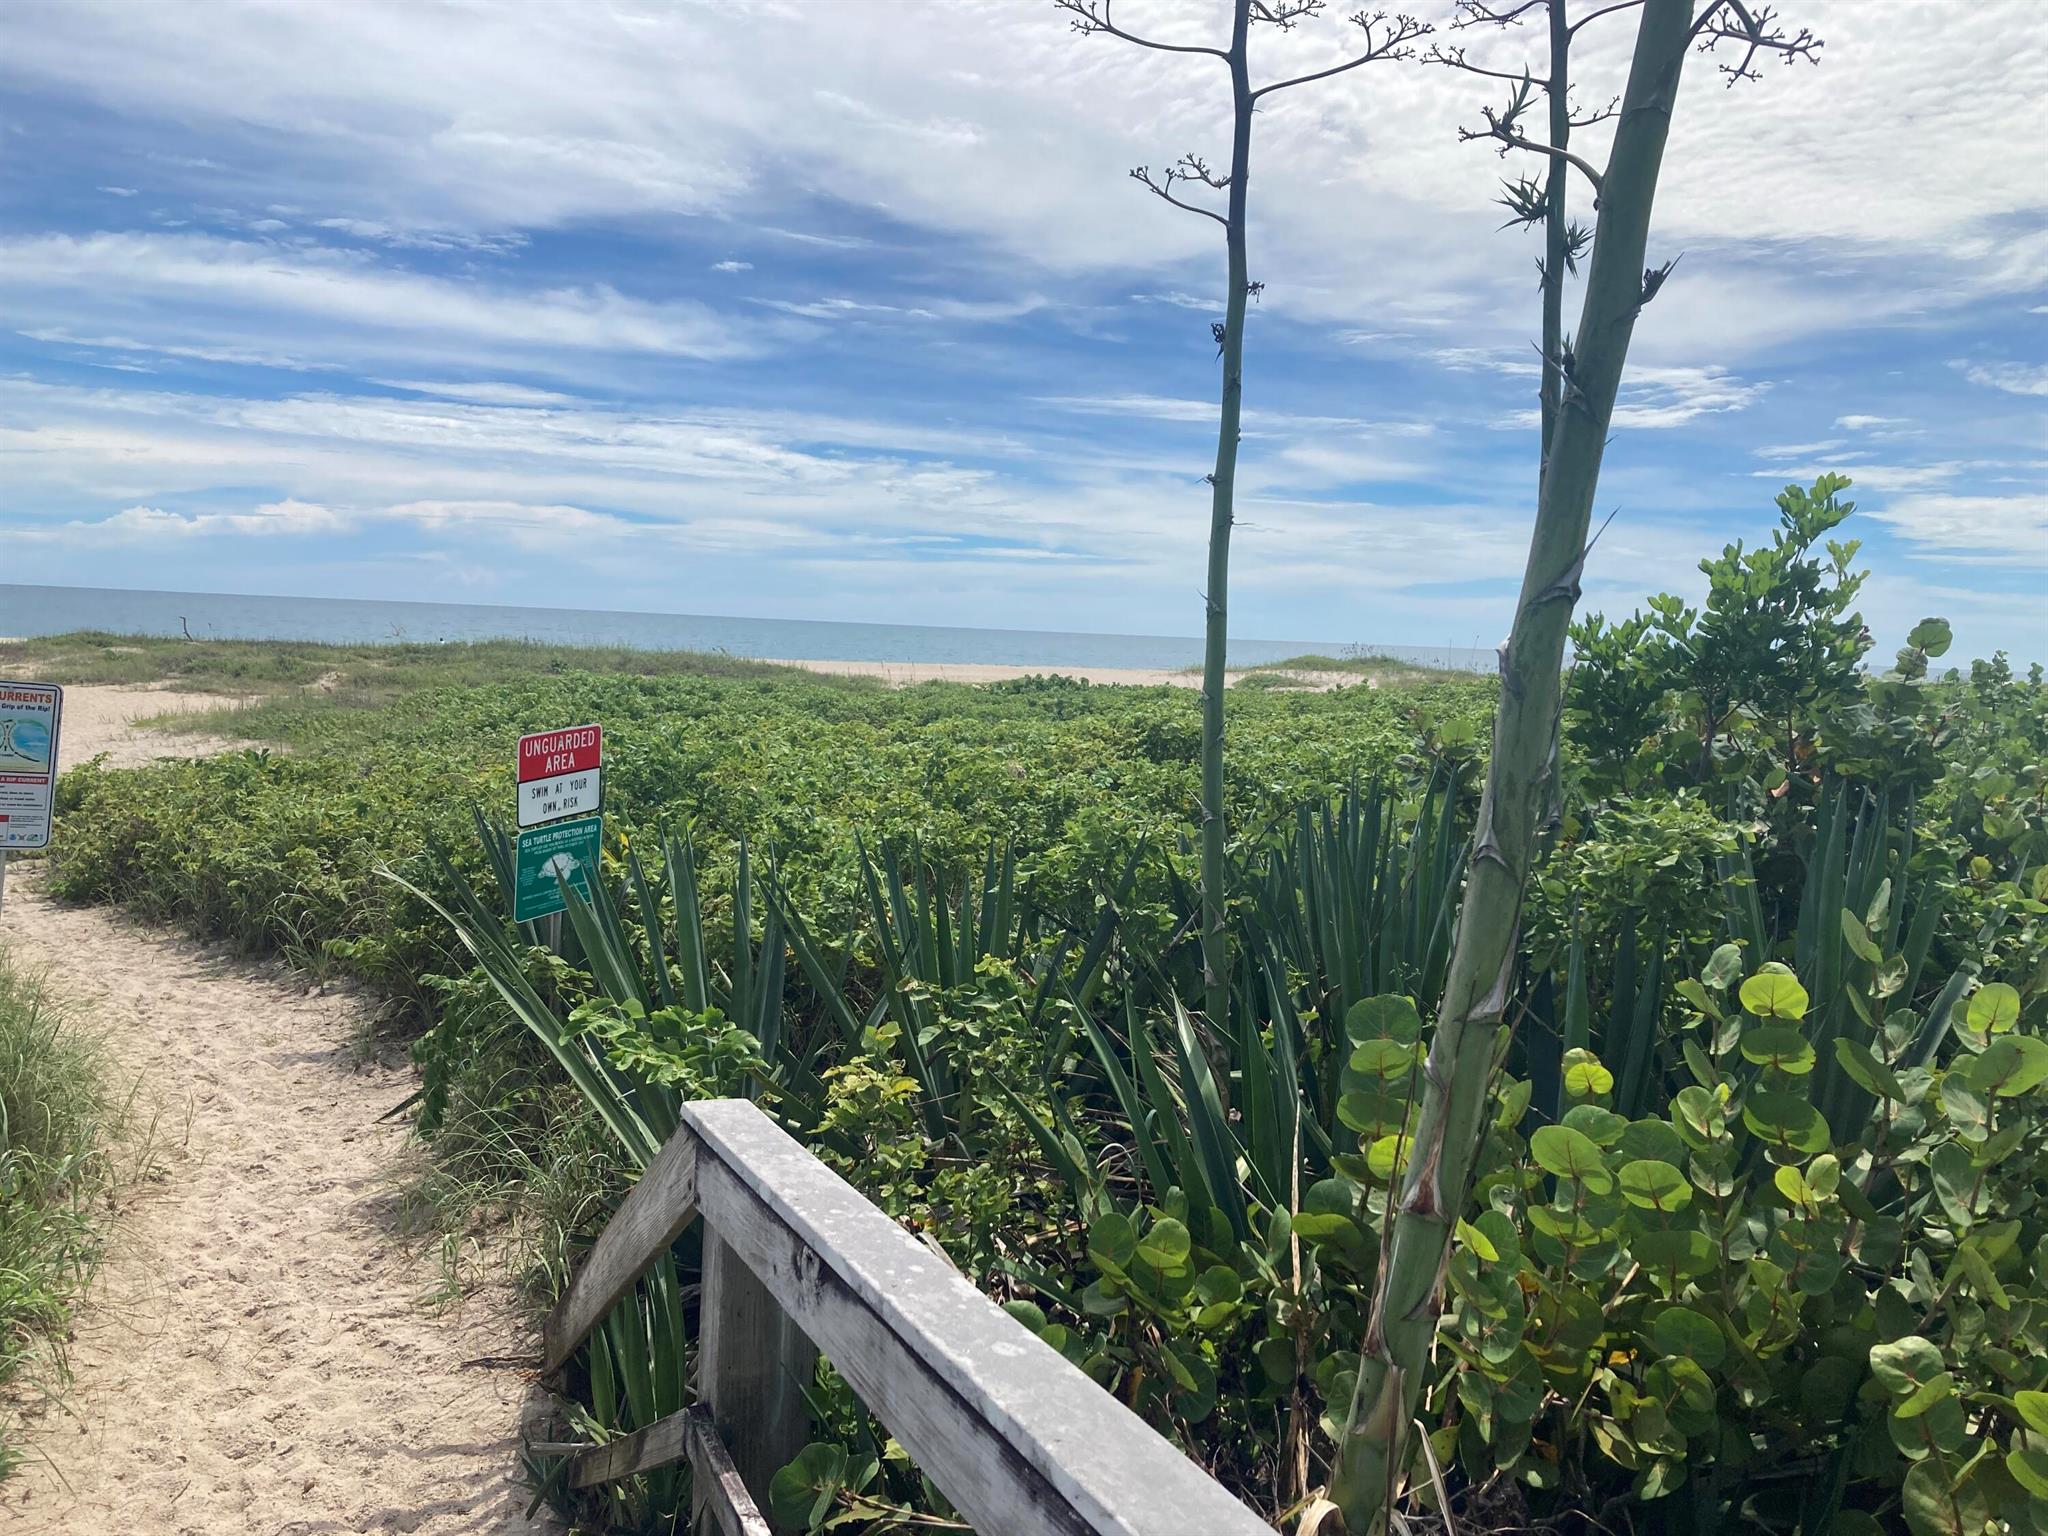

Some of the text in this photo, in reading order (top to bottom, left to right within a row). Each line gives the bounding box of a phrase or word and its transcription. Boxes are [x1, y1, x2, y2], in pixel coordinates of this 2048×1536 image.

[525, 730, 595, 757] UNGUARDED
[545, 752, 575, 773] AREA
[531, 778, 587, 799] SWIM AT YOUR
[563, 797, 578, 809] RISK
[522, 838, 532, 848] SEA
[533, 833, 552, 845] TURTLE
[552, 827, 583, 840] PROTECTION
[583, 823, 597, 834] AREA
